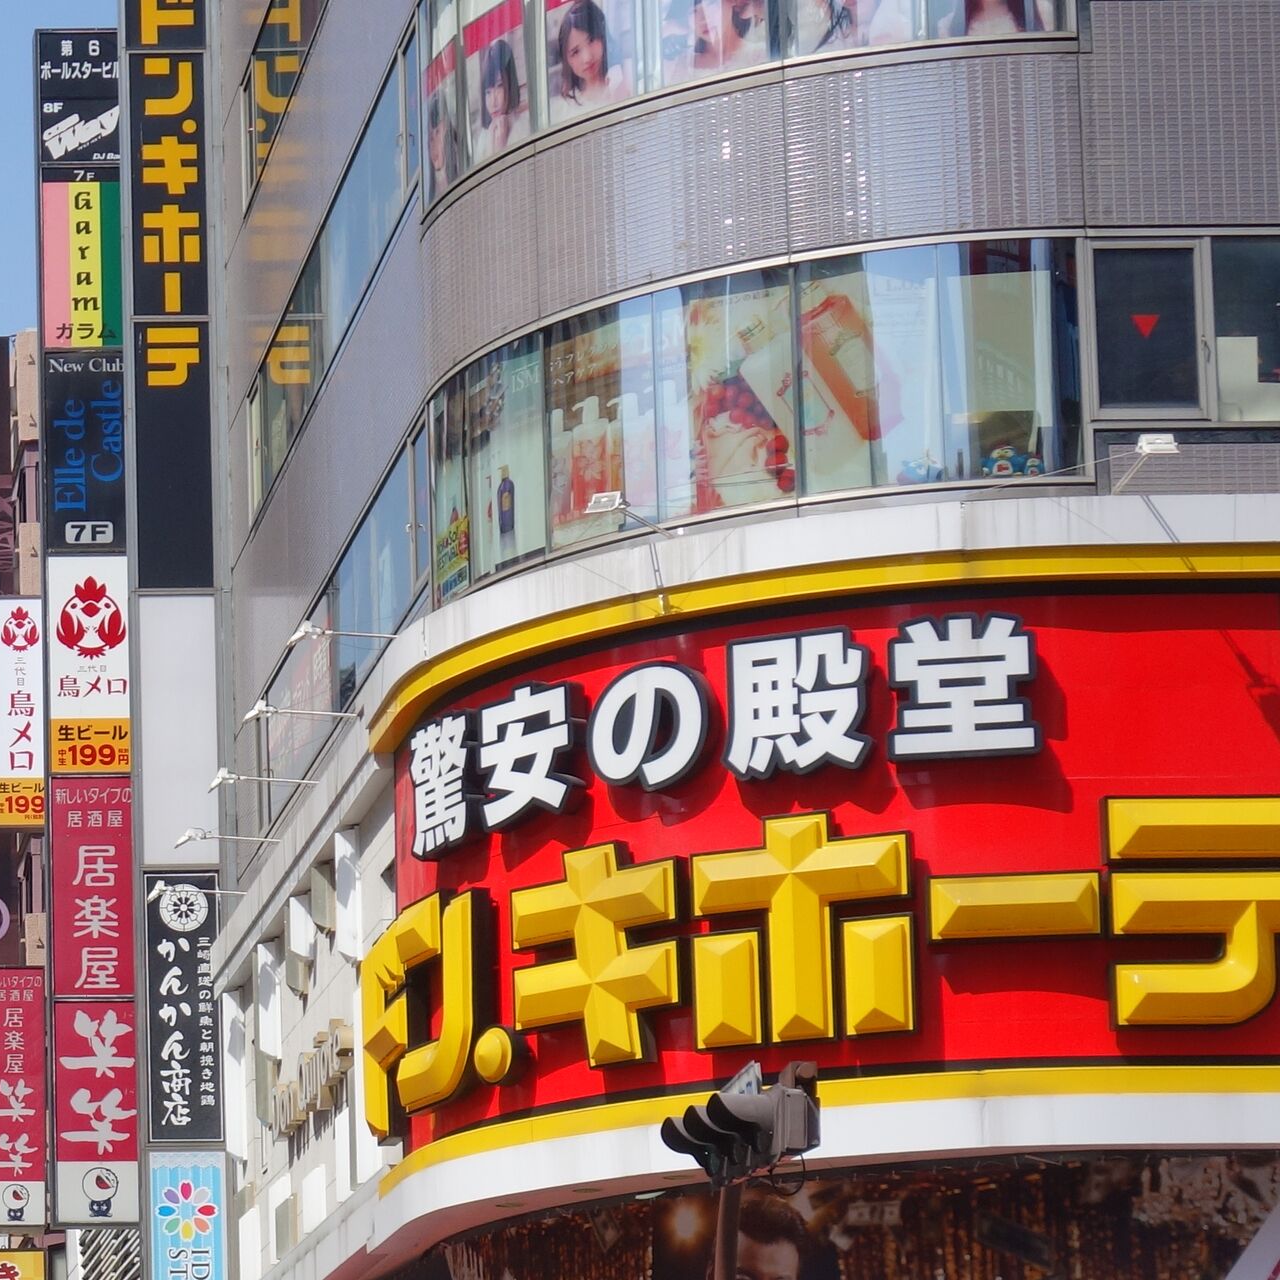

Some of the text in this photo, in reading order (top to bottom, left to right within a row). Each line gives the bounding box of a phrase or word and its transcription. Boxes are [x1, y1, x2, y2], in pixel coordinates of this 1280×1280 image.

[43, 101, 64, 114] 8F
[73, 169, 95, 182] 7F
[72, 190, 101, 312] Garam
[56, 323, 118, 340] ガラム
[49, 356, 125, 373] New Club
[91, 379, 124, 484] Castle
[53, 398, 87, 513] Elle de
[67, 523, 113, 543] 7F
[57, 675, 127, 698] 鳥メロ
[58, 724, 128, 742] 生ビール
[408, 612, 1040, 860] 驚安の殿堂
[67, 811, 123, 828] 居酒屋
[73, 845, 120, 989] 居楽屋
[2, 1008, 25, 1074] 居楽屋
[157, 938, 192, 1127] かんかん商店
[60, 1009, 137, 1155] 笑笑
